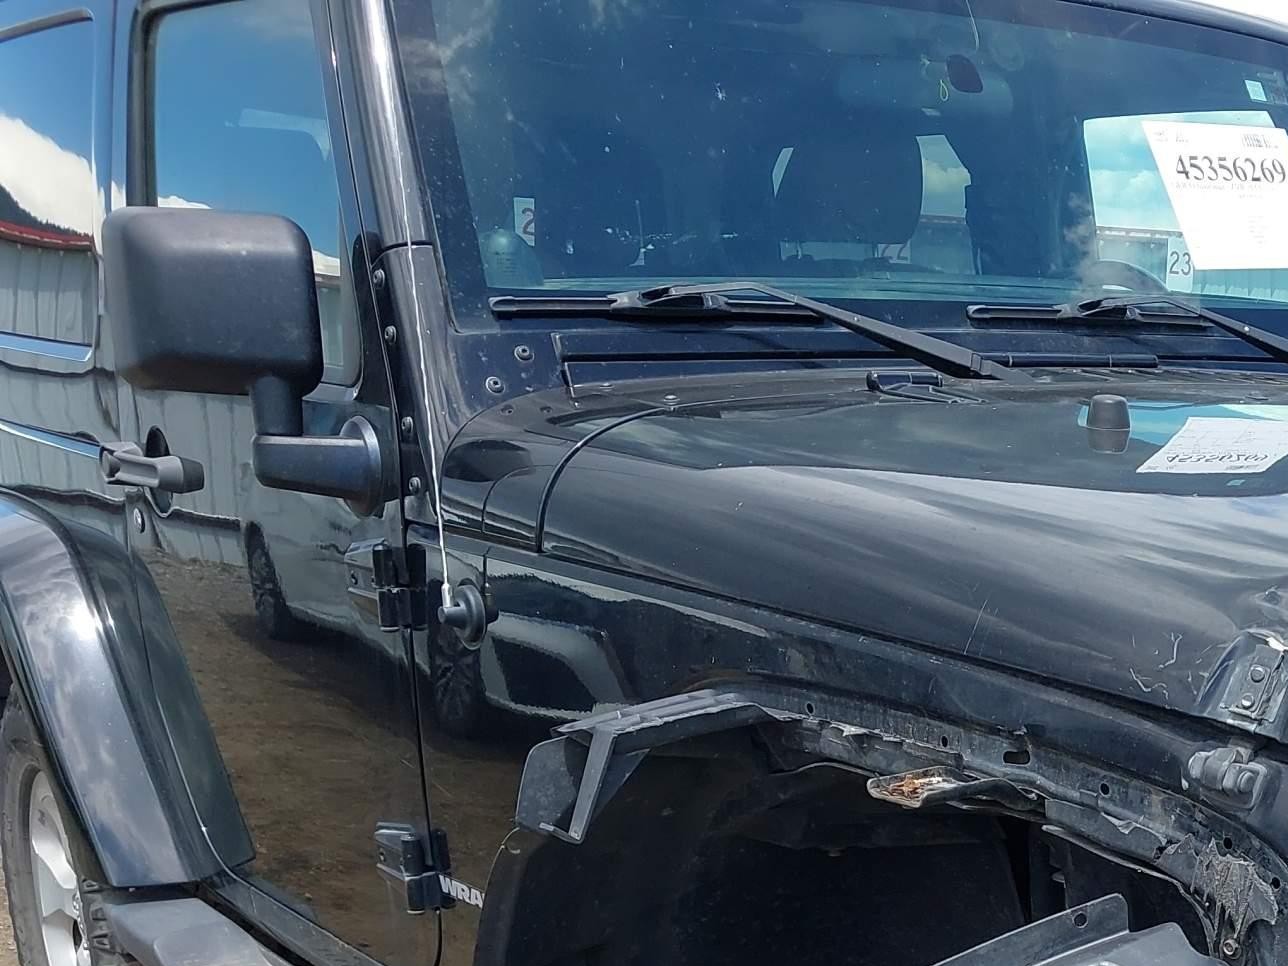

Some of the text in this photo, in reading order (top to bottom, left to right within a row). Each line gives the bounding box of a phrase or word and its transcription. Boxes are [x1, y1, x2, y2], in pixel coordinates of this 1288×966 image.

[1176, 154, 1286, 183] 45356269
[1169, 251, 1191, 275] 23
[439, 874, 485, 909] WRA
